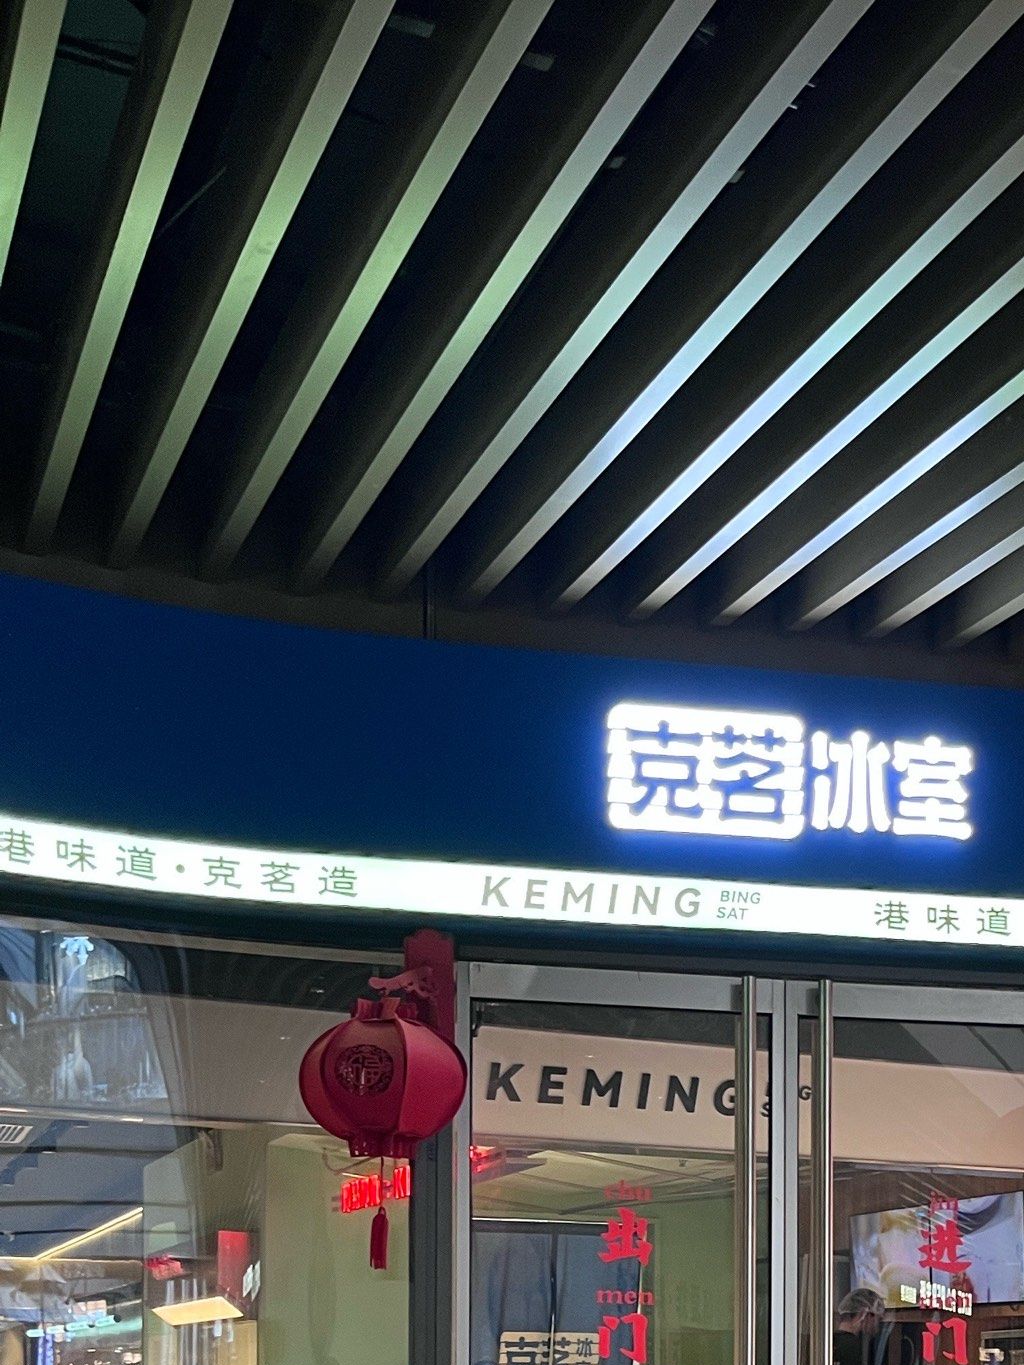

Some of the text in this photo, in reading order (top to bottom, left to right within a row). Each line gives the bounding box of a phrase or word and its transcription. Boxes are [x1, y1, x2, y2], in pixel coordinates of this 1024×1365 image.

[606, 703, 973, 840] 克茗冰室
[481, 876, 702, 918] KEMING
[719, 890, 761, 905] BING
[716, 907, 749, 921] SAT
[597, 1288, 655, 1306] men
